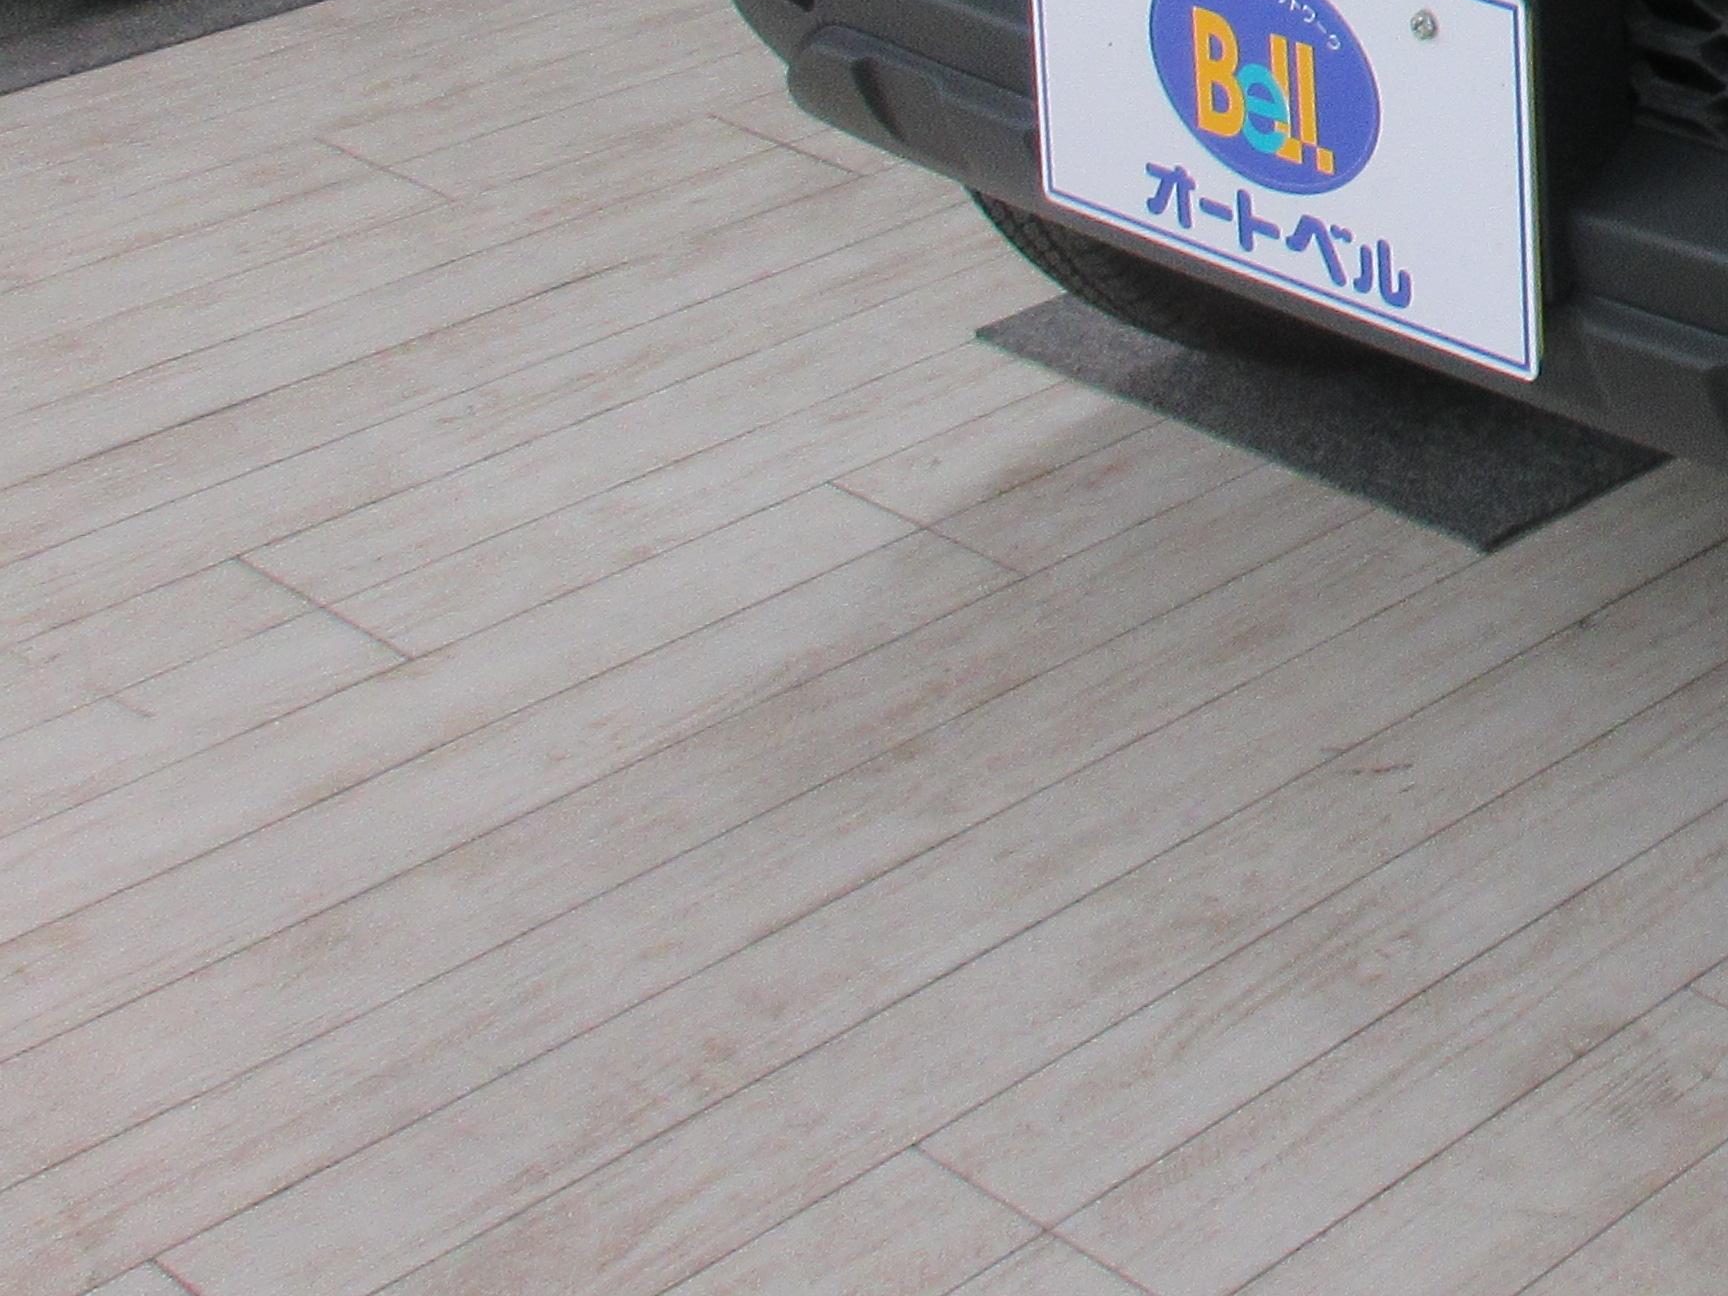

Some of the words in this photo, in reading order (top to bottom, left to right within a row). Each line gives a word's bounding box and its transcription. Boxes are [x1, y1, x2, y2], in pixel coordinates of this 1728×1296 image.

[1145, 162, 1412, 308] オートベル
